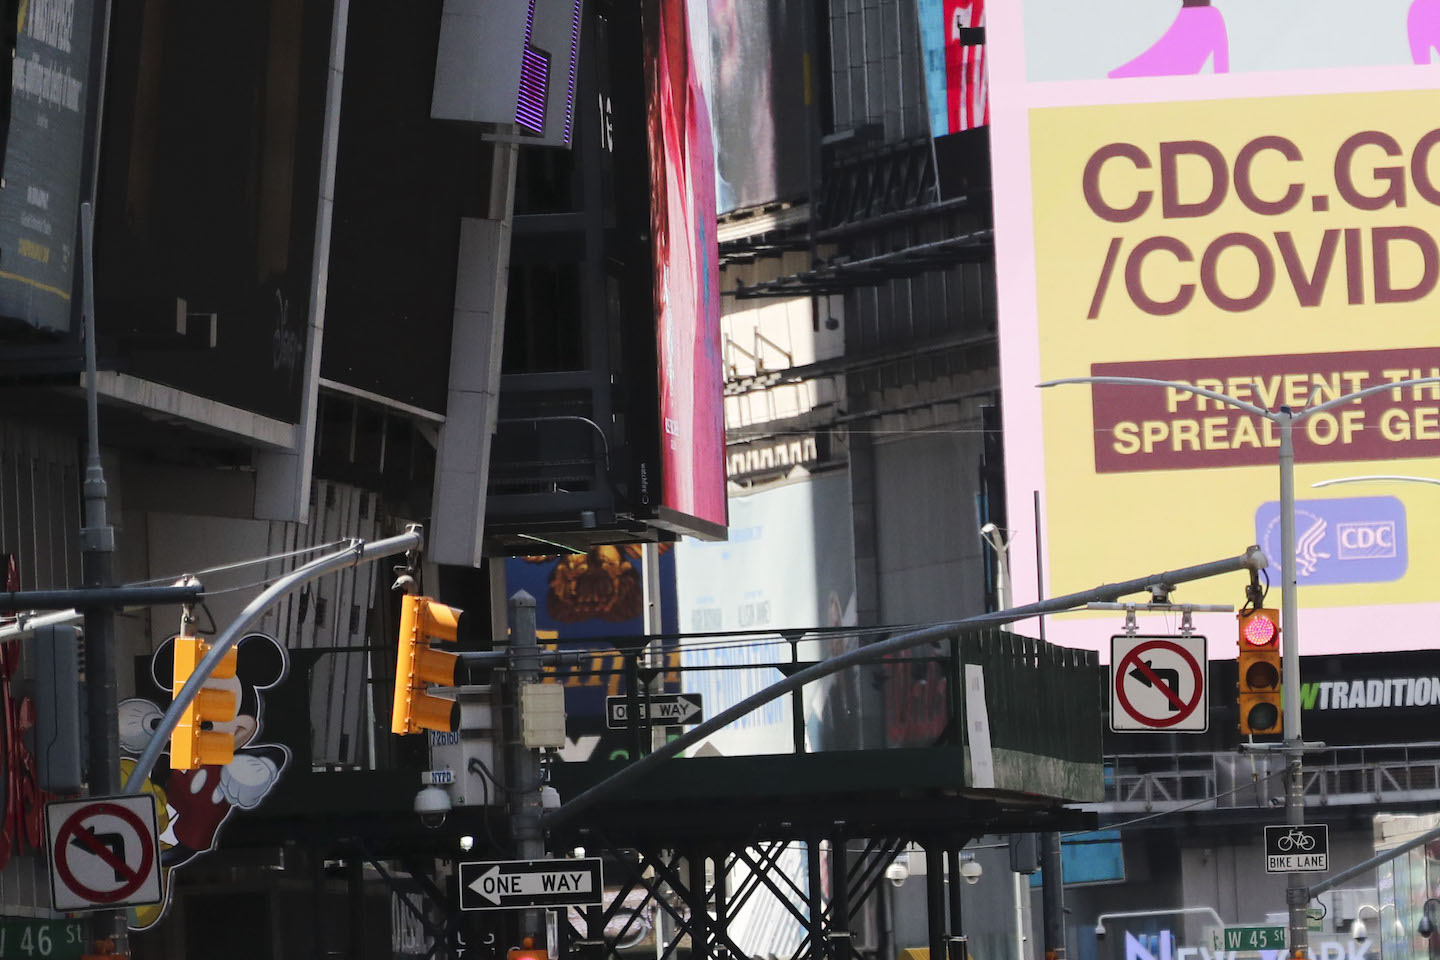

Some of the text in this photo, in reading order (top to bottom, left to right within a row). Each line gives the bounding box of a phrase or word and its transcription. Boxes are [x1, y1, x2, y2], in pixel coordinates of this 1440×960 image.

[1166, 370, 1377, 413] PREVENT
[1307, 412, 1365, 446] OF
[1341, 526, 1392, 550] CDC
[659, 704, 689, 717] WAY
[432, 772, 451, 783] NYPD
[1270, 856, 1325, 869] BIKE LANE
[483, 873, 583, 894] ONE WAY
[20, 926, 52, 956] 46
[66, 924, 82, 943] St
[1228, 930, 1284, 948] W 45 St
